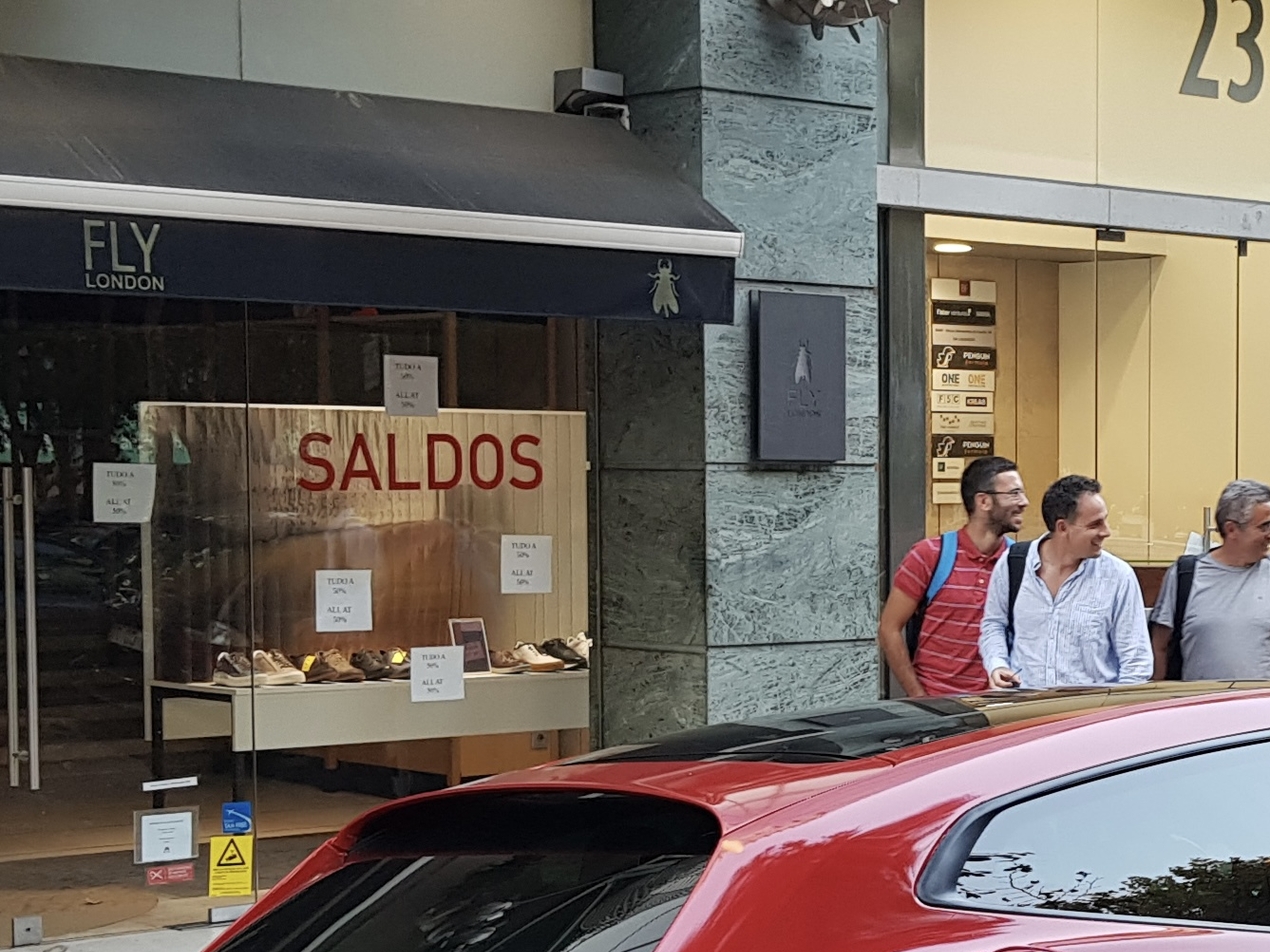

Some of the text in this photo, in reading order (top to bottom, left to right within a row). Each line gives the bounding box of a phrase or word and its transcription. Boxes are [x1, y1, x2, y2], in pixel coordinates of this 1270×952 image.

[83, 219, 161, 273] FLY
[85, 273, 165, 291] LONDON
[941, 373, 986, 385] ONE ONE
[297, 432, 543, 491] SALDOS
